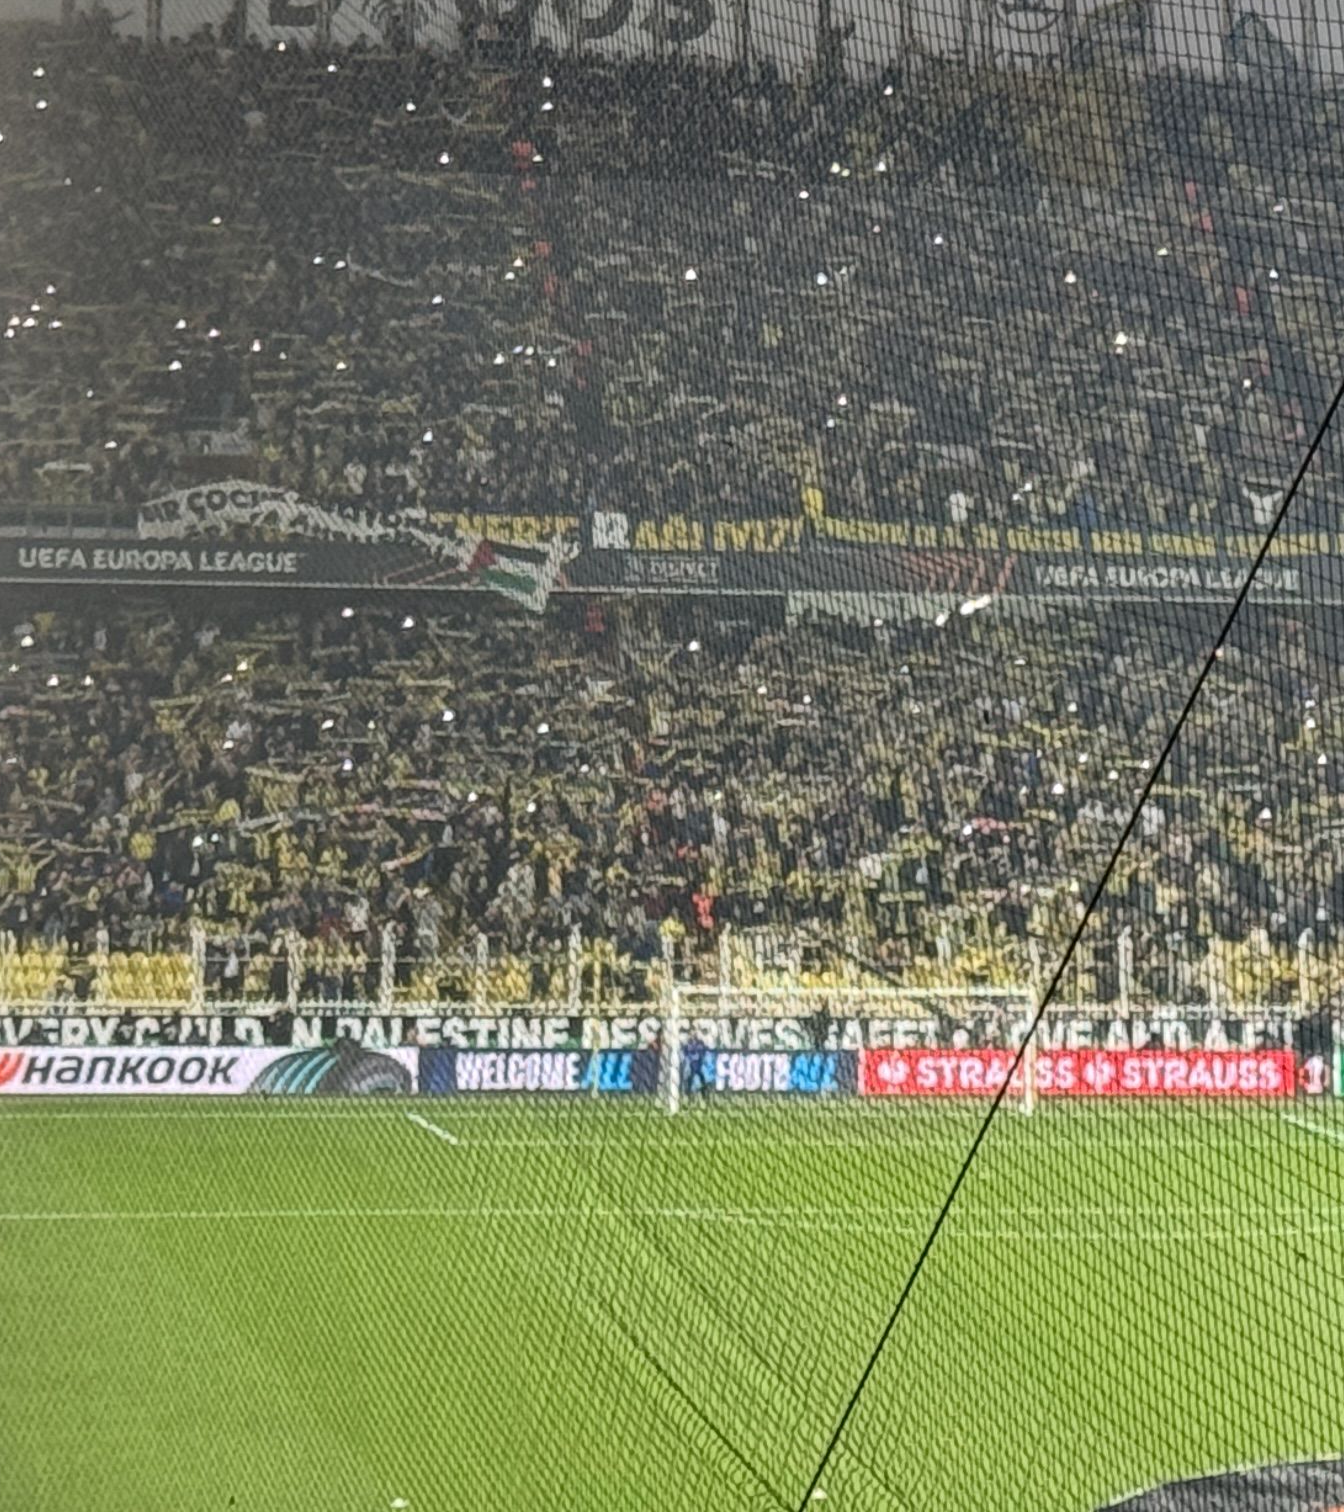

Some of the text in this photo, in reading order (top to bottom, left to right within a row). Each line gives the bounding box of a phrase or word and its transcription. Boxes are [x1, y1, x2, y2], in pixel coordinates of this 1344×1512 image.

[18, 546, 298, 574] UEFA EUROPA LEAGUE
[456, 1052, 581, 1090] WELCOME
[1122, 1058, 1282, 1090] STRAUSS
